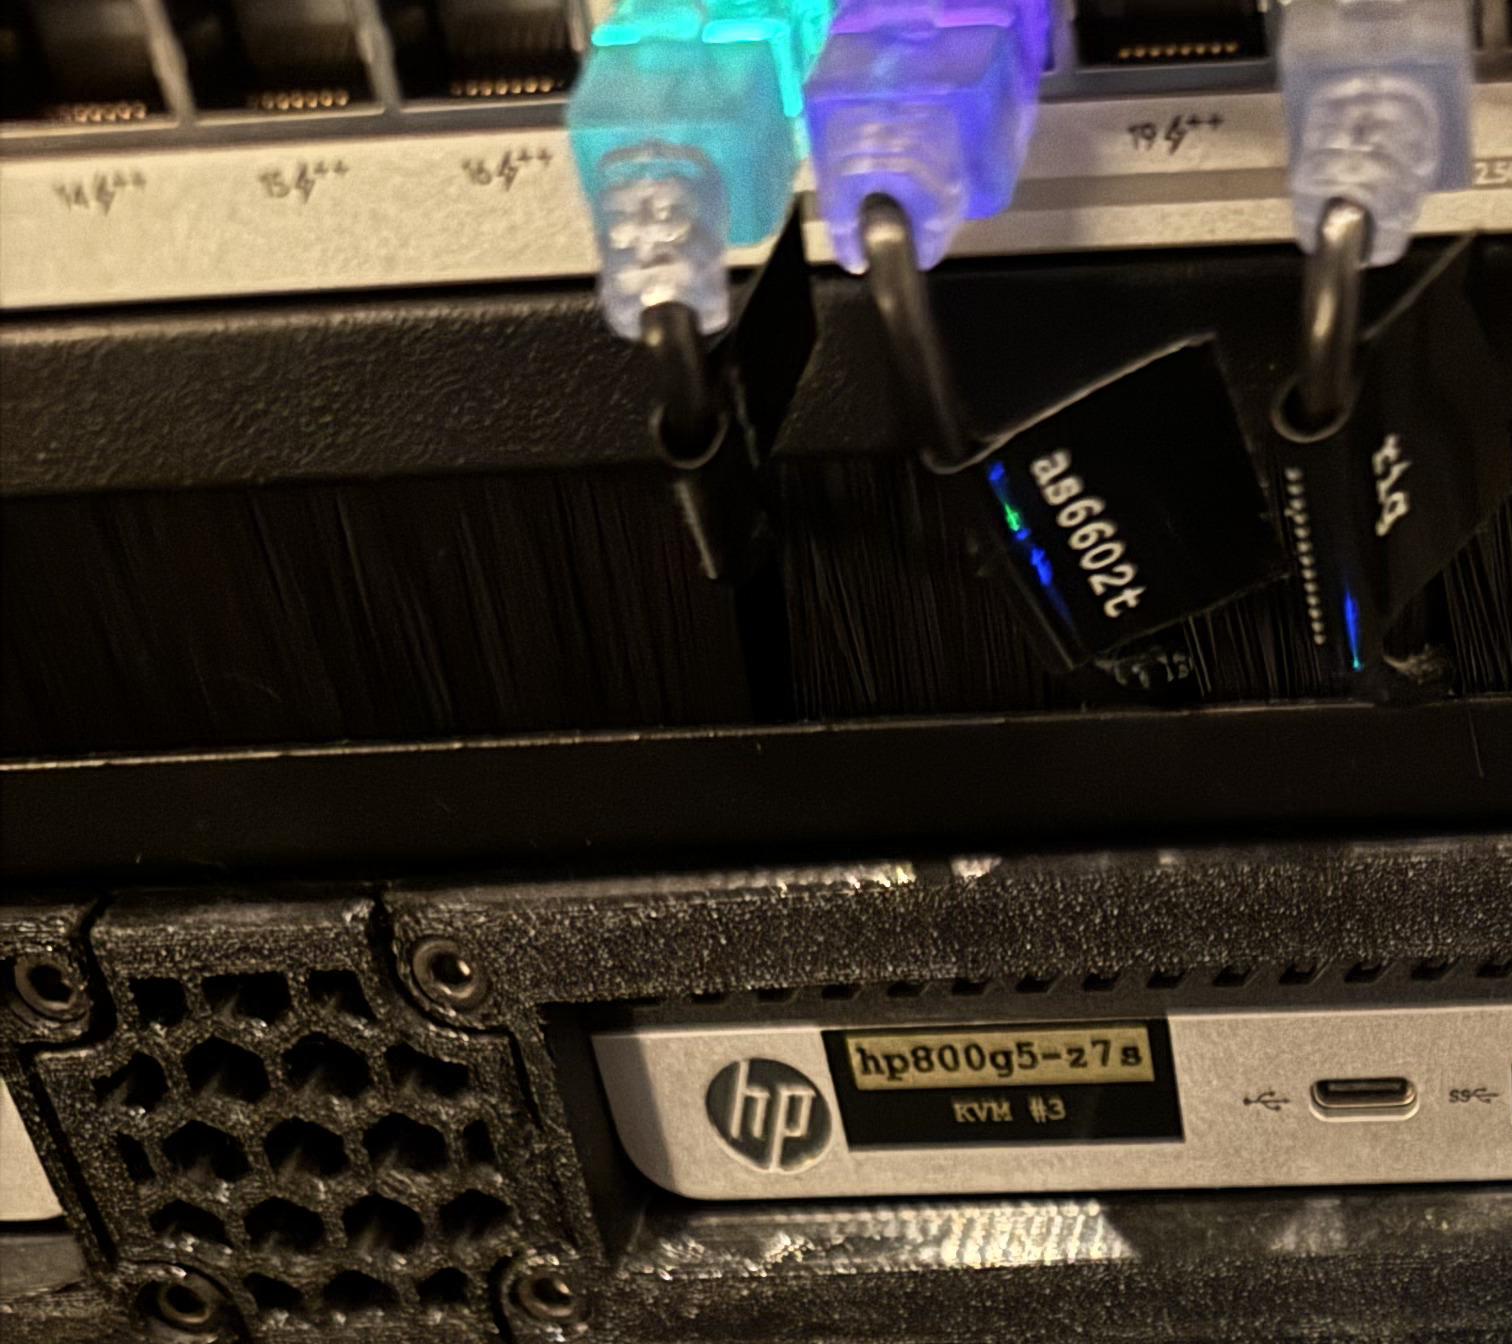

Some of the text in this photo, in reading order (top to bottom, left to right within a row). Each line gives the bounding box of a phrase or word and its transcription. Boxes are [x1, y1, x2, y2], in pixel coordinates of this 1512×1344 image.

[729, 1058, 817, 1172] hp
[953, 1095, 1067, 1123] KVM #3
